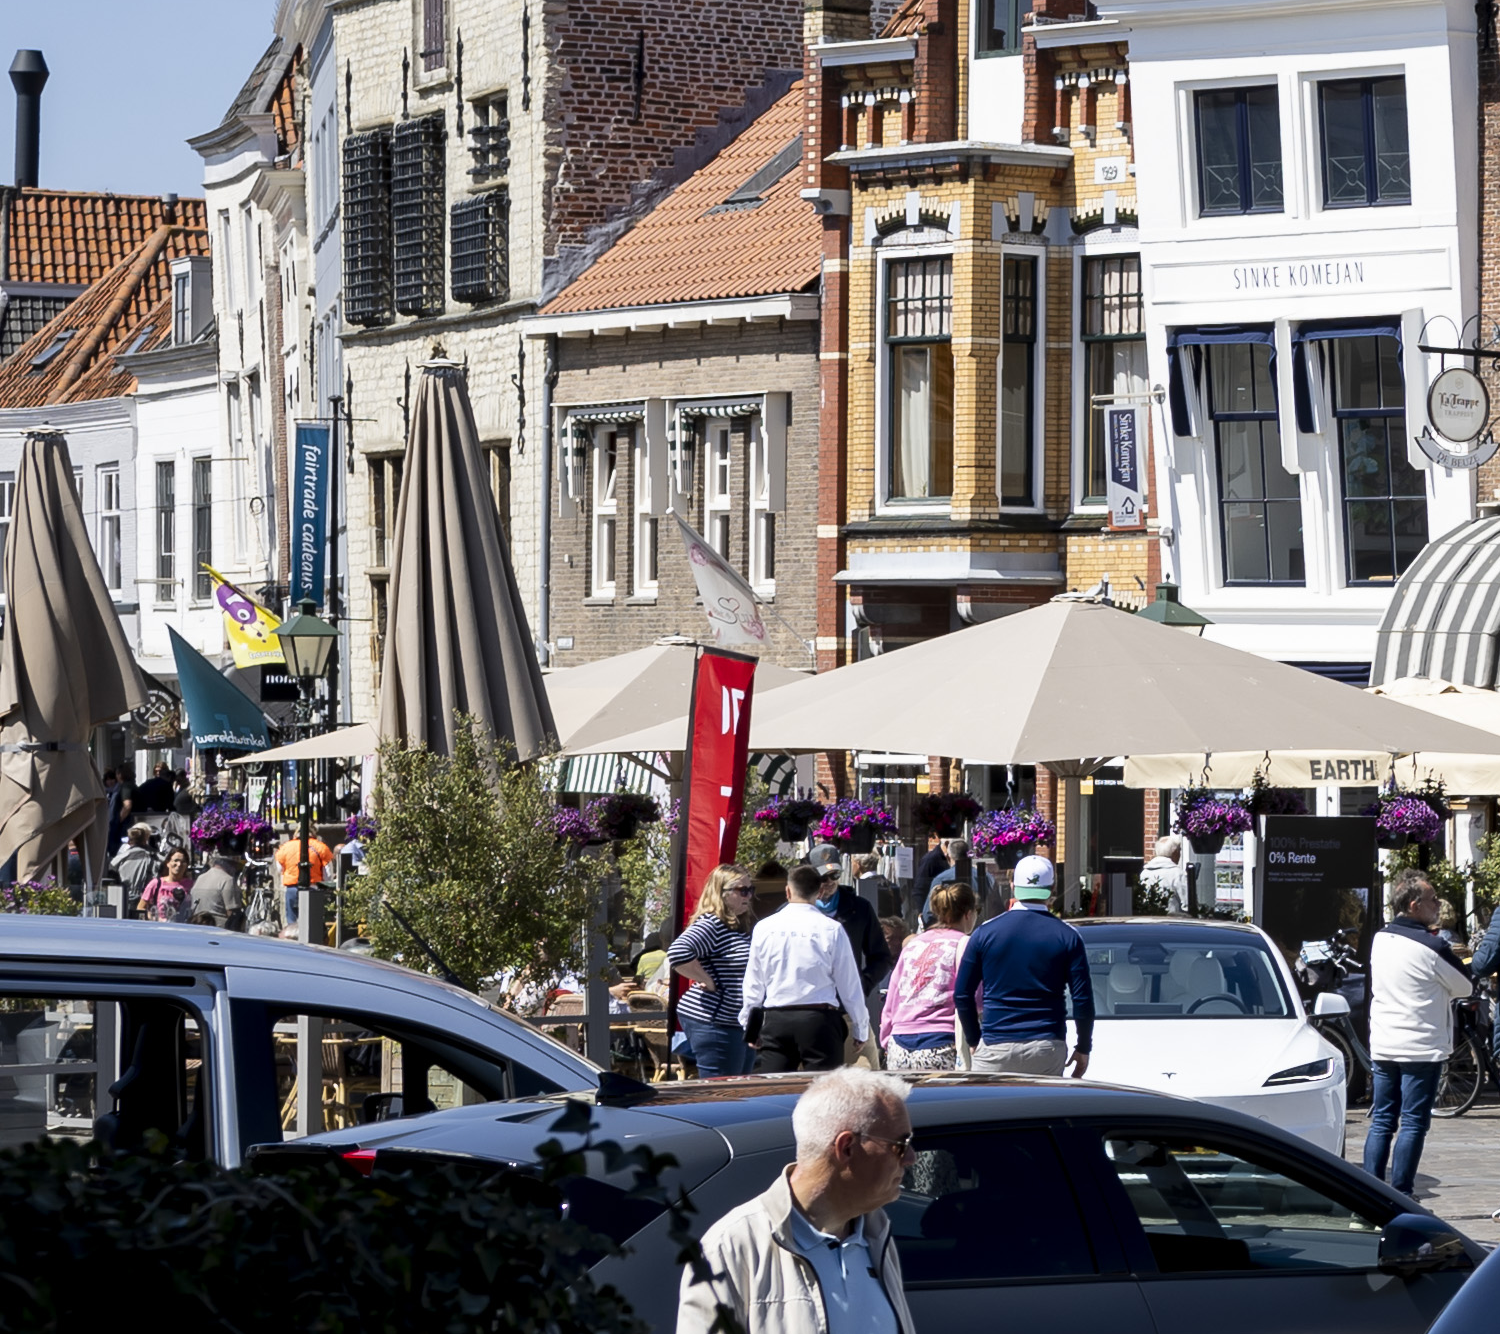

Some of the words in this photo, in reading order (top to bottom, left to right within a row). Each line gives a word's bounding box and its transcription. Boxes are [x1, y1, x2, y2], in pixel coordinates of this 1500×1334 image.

[1232, 265, 1281, 290] SINKE
[1288, 261, 1365, 286] KOMEJAN
[1450, 392, 1479, 409] Trappe
[1119, 413, 1132, 440] Sinke
[1118, 441, 1133, 483] Komejan
[1451, 454, 1480, 467] BEUZE
[302, 443, 320, 519] fairtrade
[301, 523, 316, 590] cadeaus
[195, 730, 267, 747] wereldwinkel
[1310, 759, 1376, 781] EARTH
[1270, 837, 1296, 849] 100%
[1268, 851, 1286, 864] 0%
[1288, 852, 1316, 864] Rente
